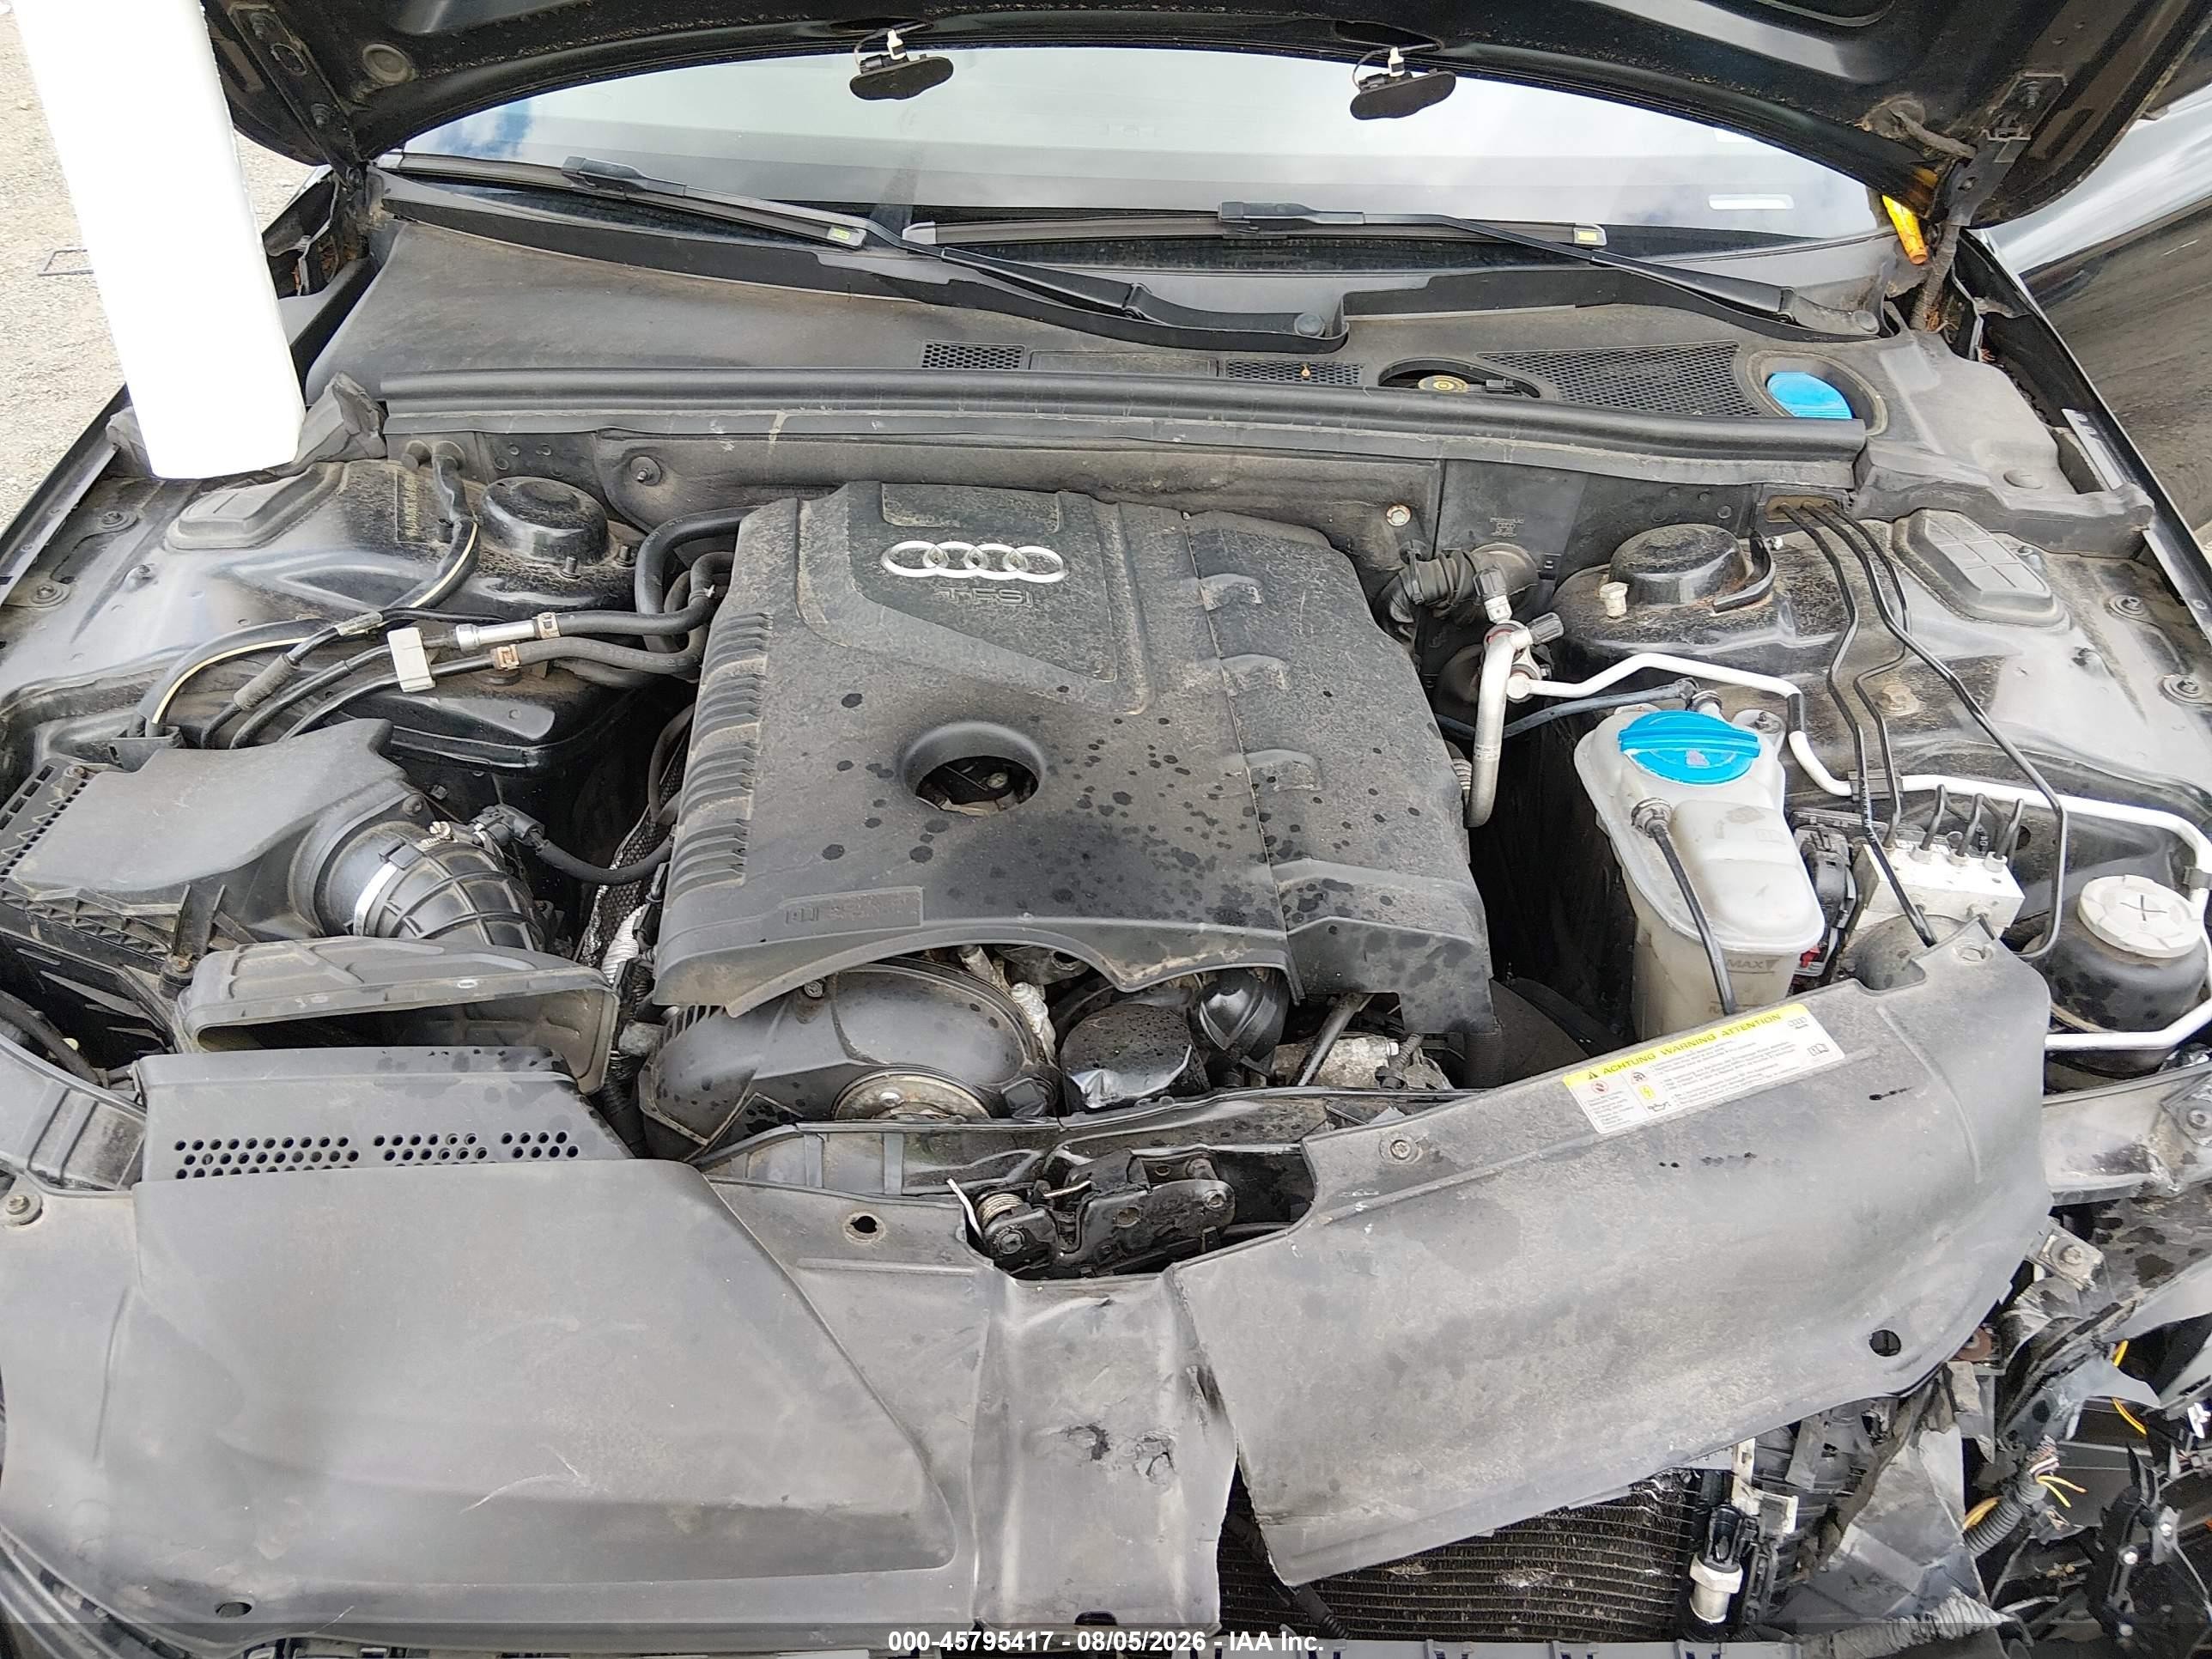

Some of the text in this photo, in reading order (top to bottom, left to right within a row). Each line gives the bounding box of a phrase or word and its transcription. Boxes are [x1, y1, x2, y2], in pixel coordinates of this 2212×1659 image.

[935, 586, 1034, 609] TFSI
[1725, 958, 1764, 969] MAX
[1602, 1013, 1782, 1075] ACHTUNG WARNING ATTENTION
